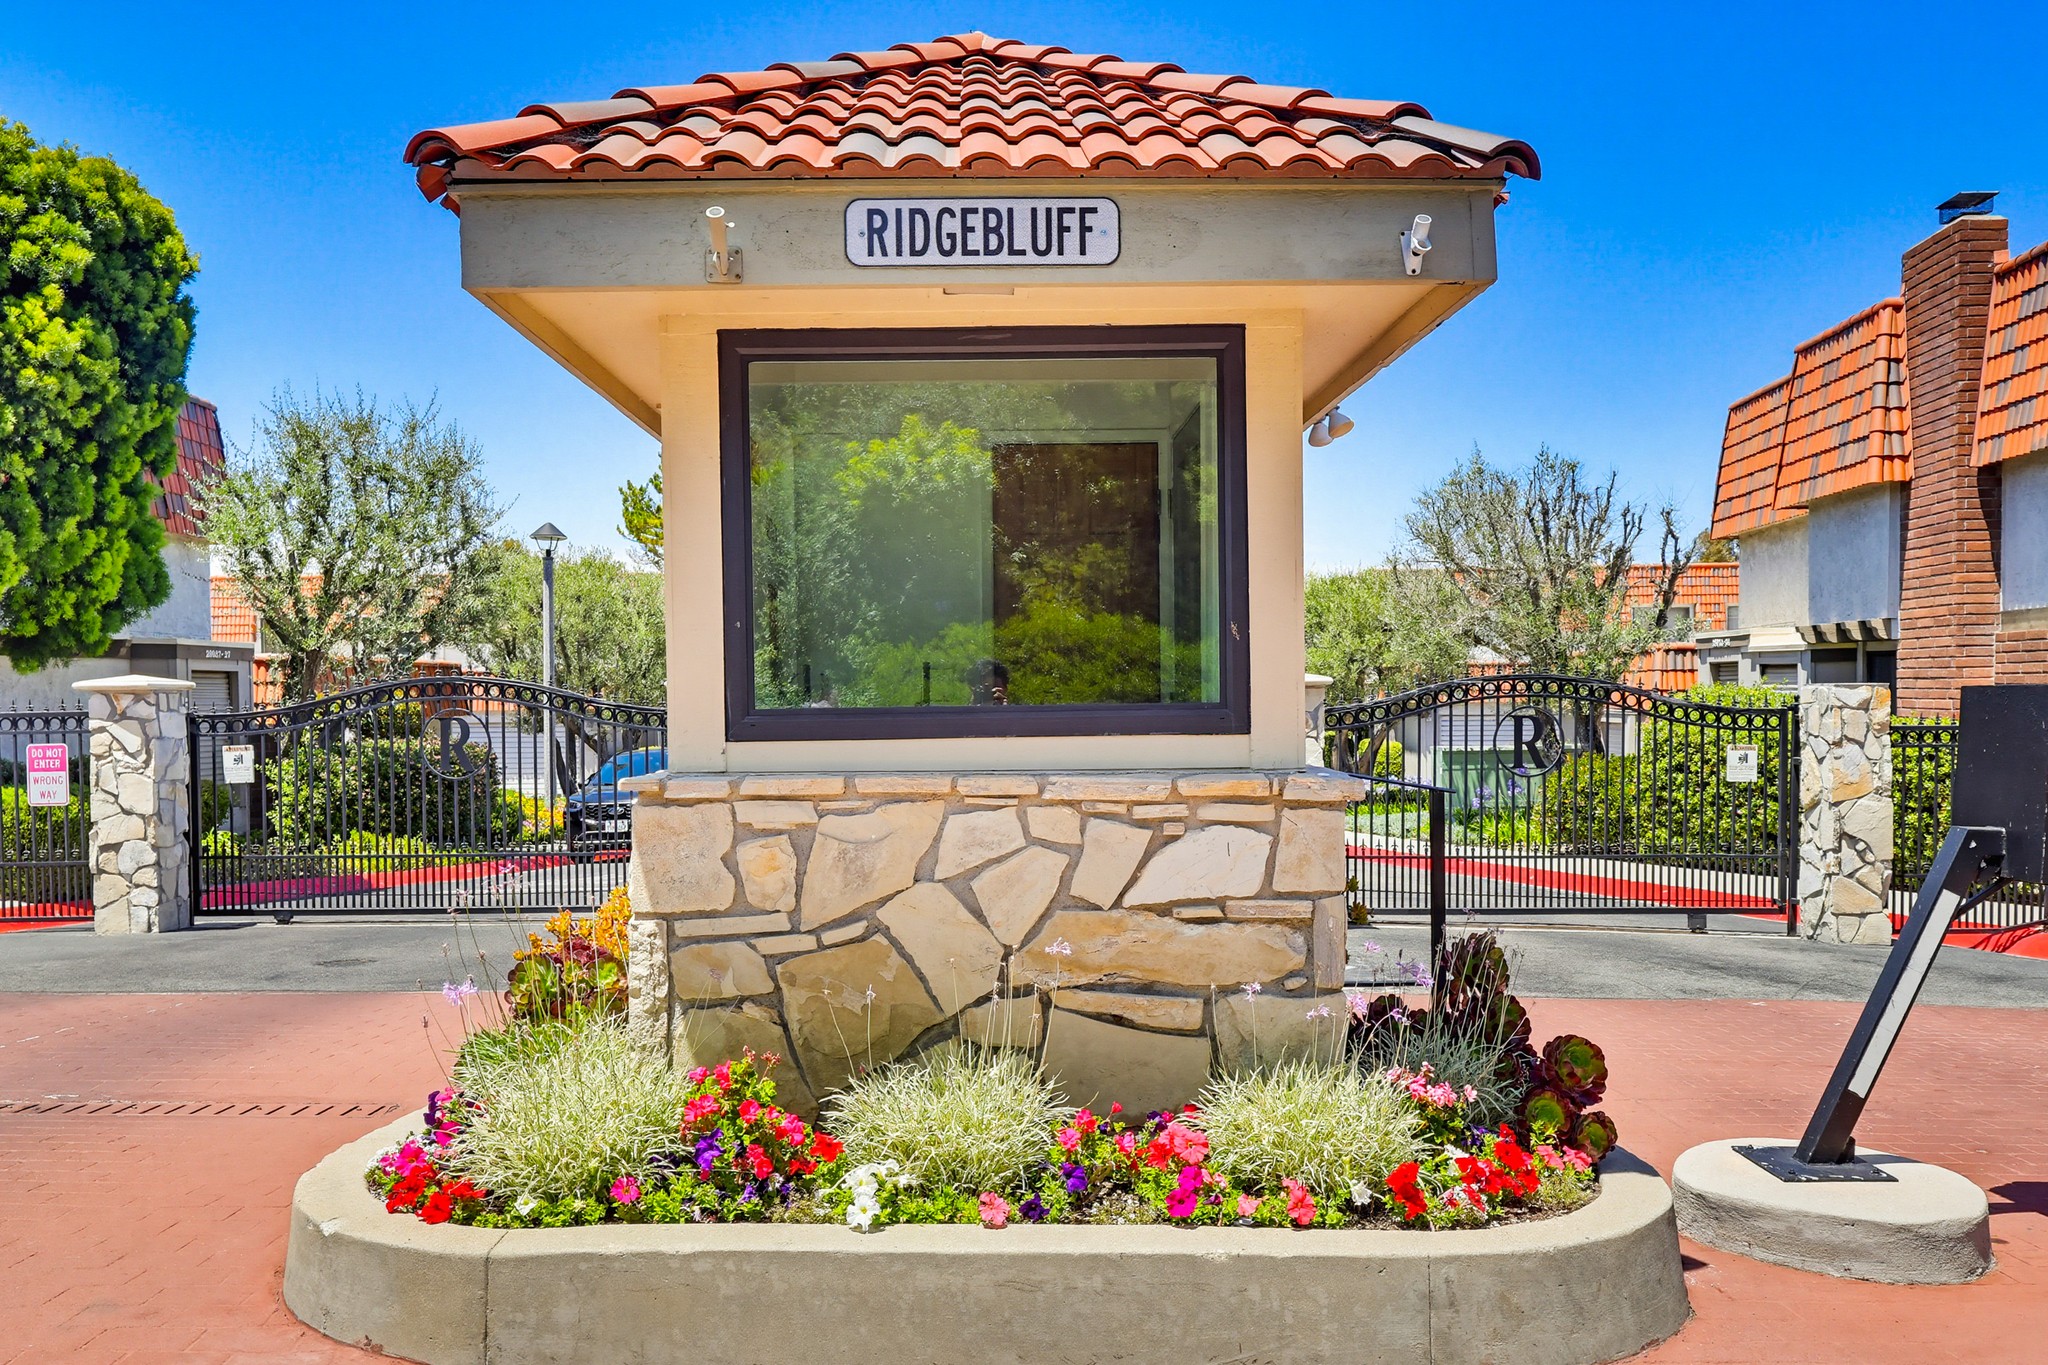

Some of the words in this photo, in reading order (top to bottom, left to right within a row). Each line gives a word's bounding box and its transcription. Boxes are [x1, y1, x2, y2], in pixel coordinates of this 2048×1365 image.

[866, 206, 1099, 258] RIDGEBLUFF
[434, 716, 475, 773] R
[1508, 714, 1549, 769] R
[31, 748, 43, 758] DO
[46, 748, 63, 758] NOT
[34, 759, 61, 769] ENTER
[32, 775, 64, 785] WRONG
[39, 790, 57, 800] WAY
